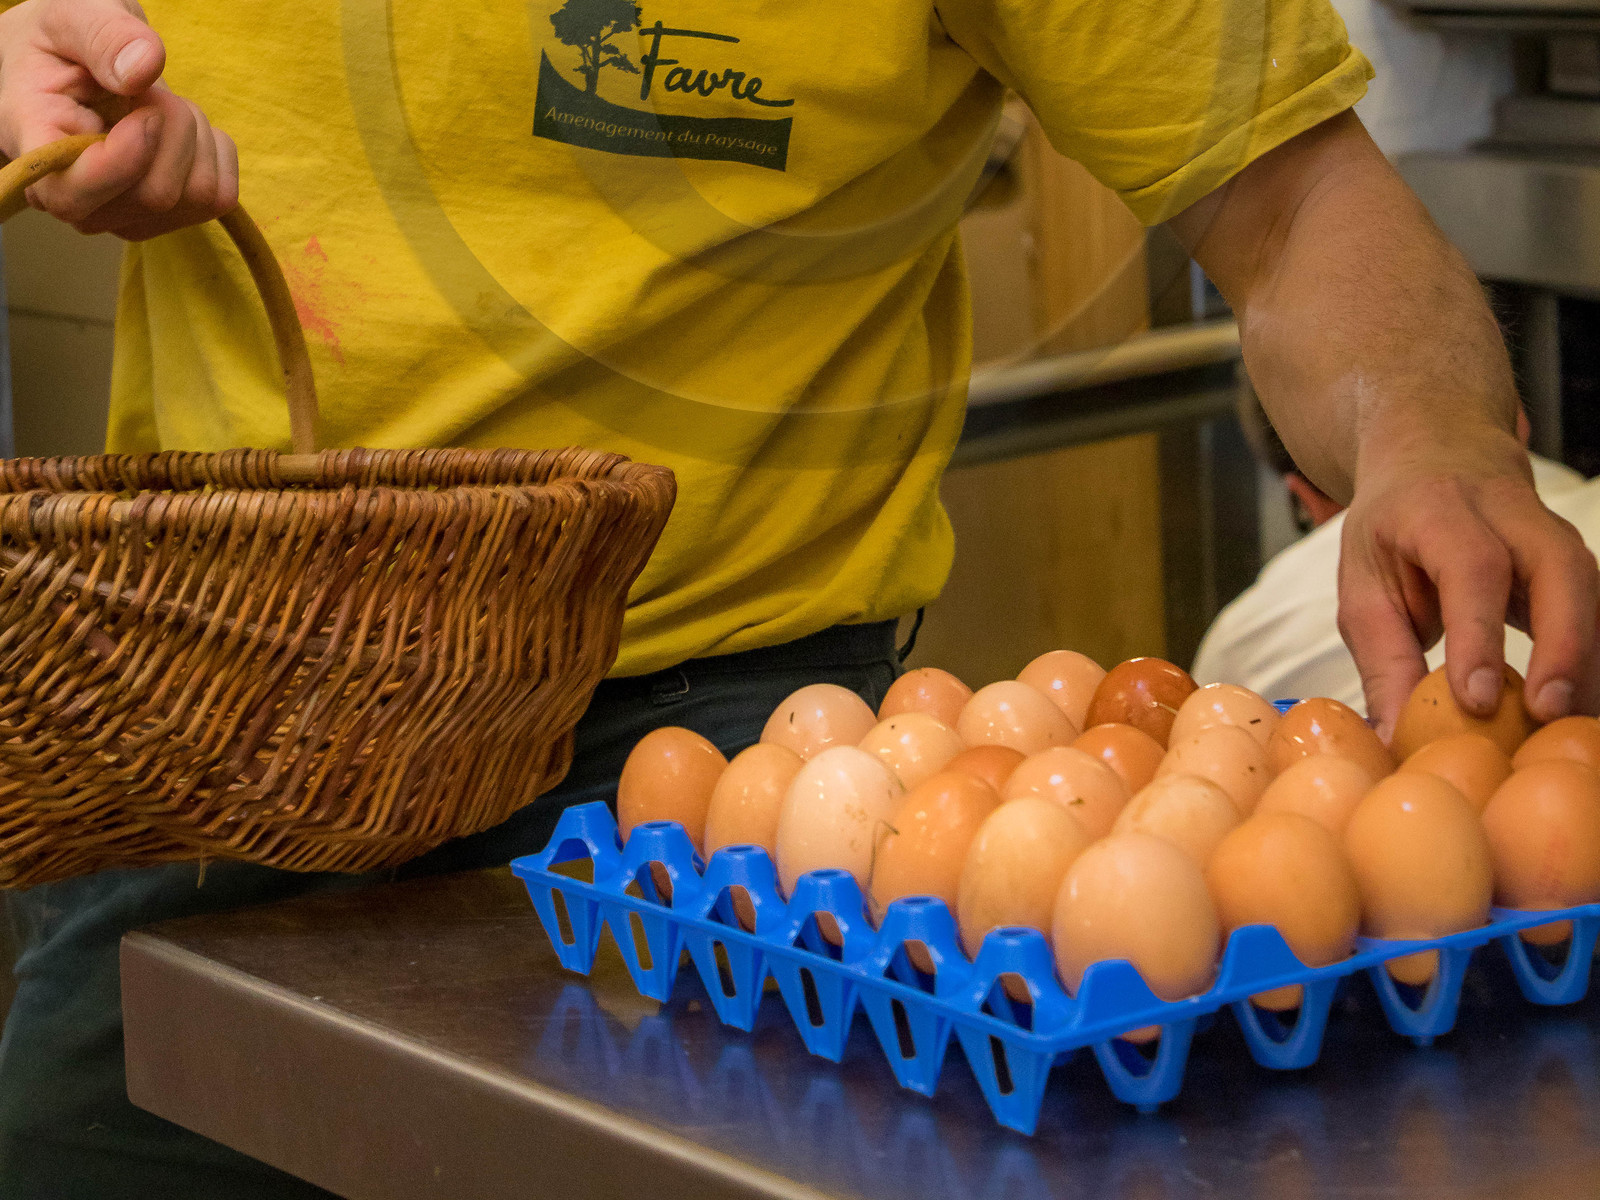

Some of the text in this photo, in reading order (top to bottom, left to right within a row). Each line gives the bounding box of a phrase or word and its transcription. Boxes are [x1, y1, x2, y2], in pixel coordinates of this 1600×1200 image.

[638, 20, 795, 107] Favre
[677, 129, 701, 144] du
[704, 133, 779, 155] Paysage
